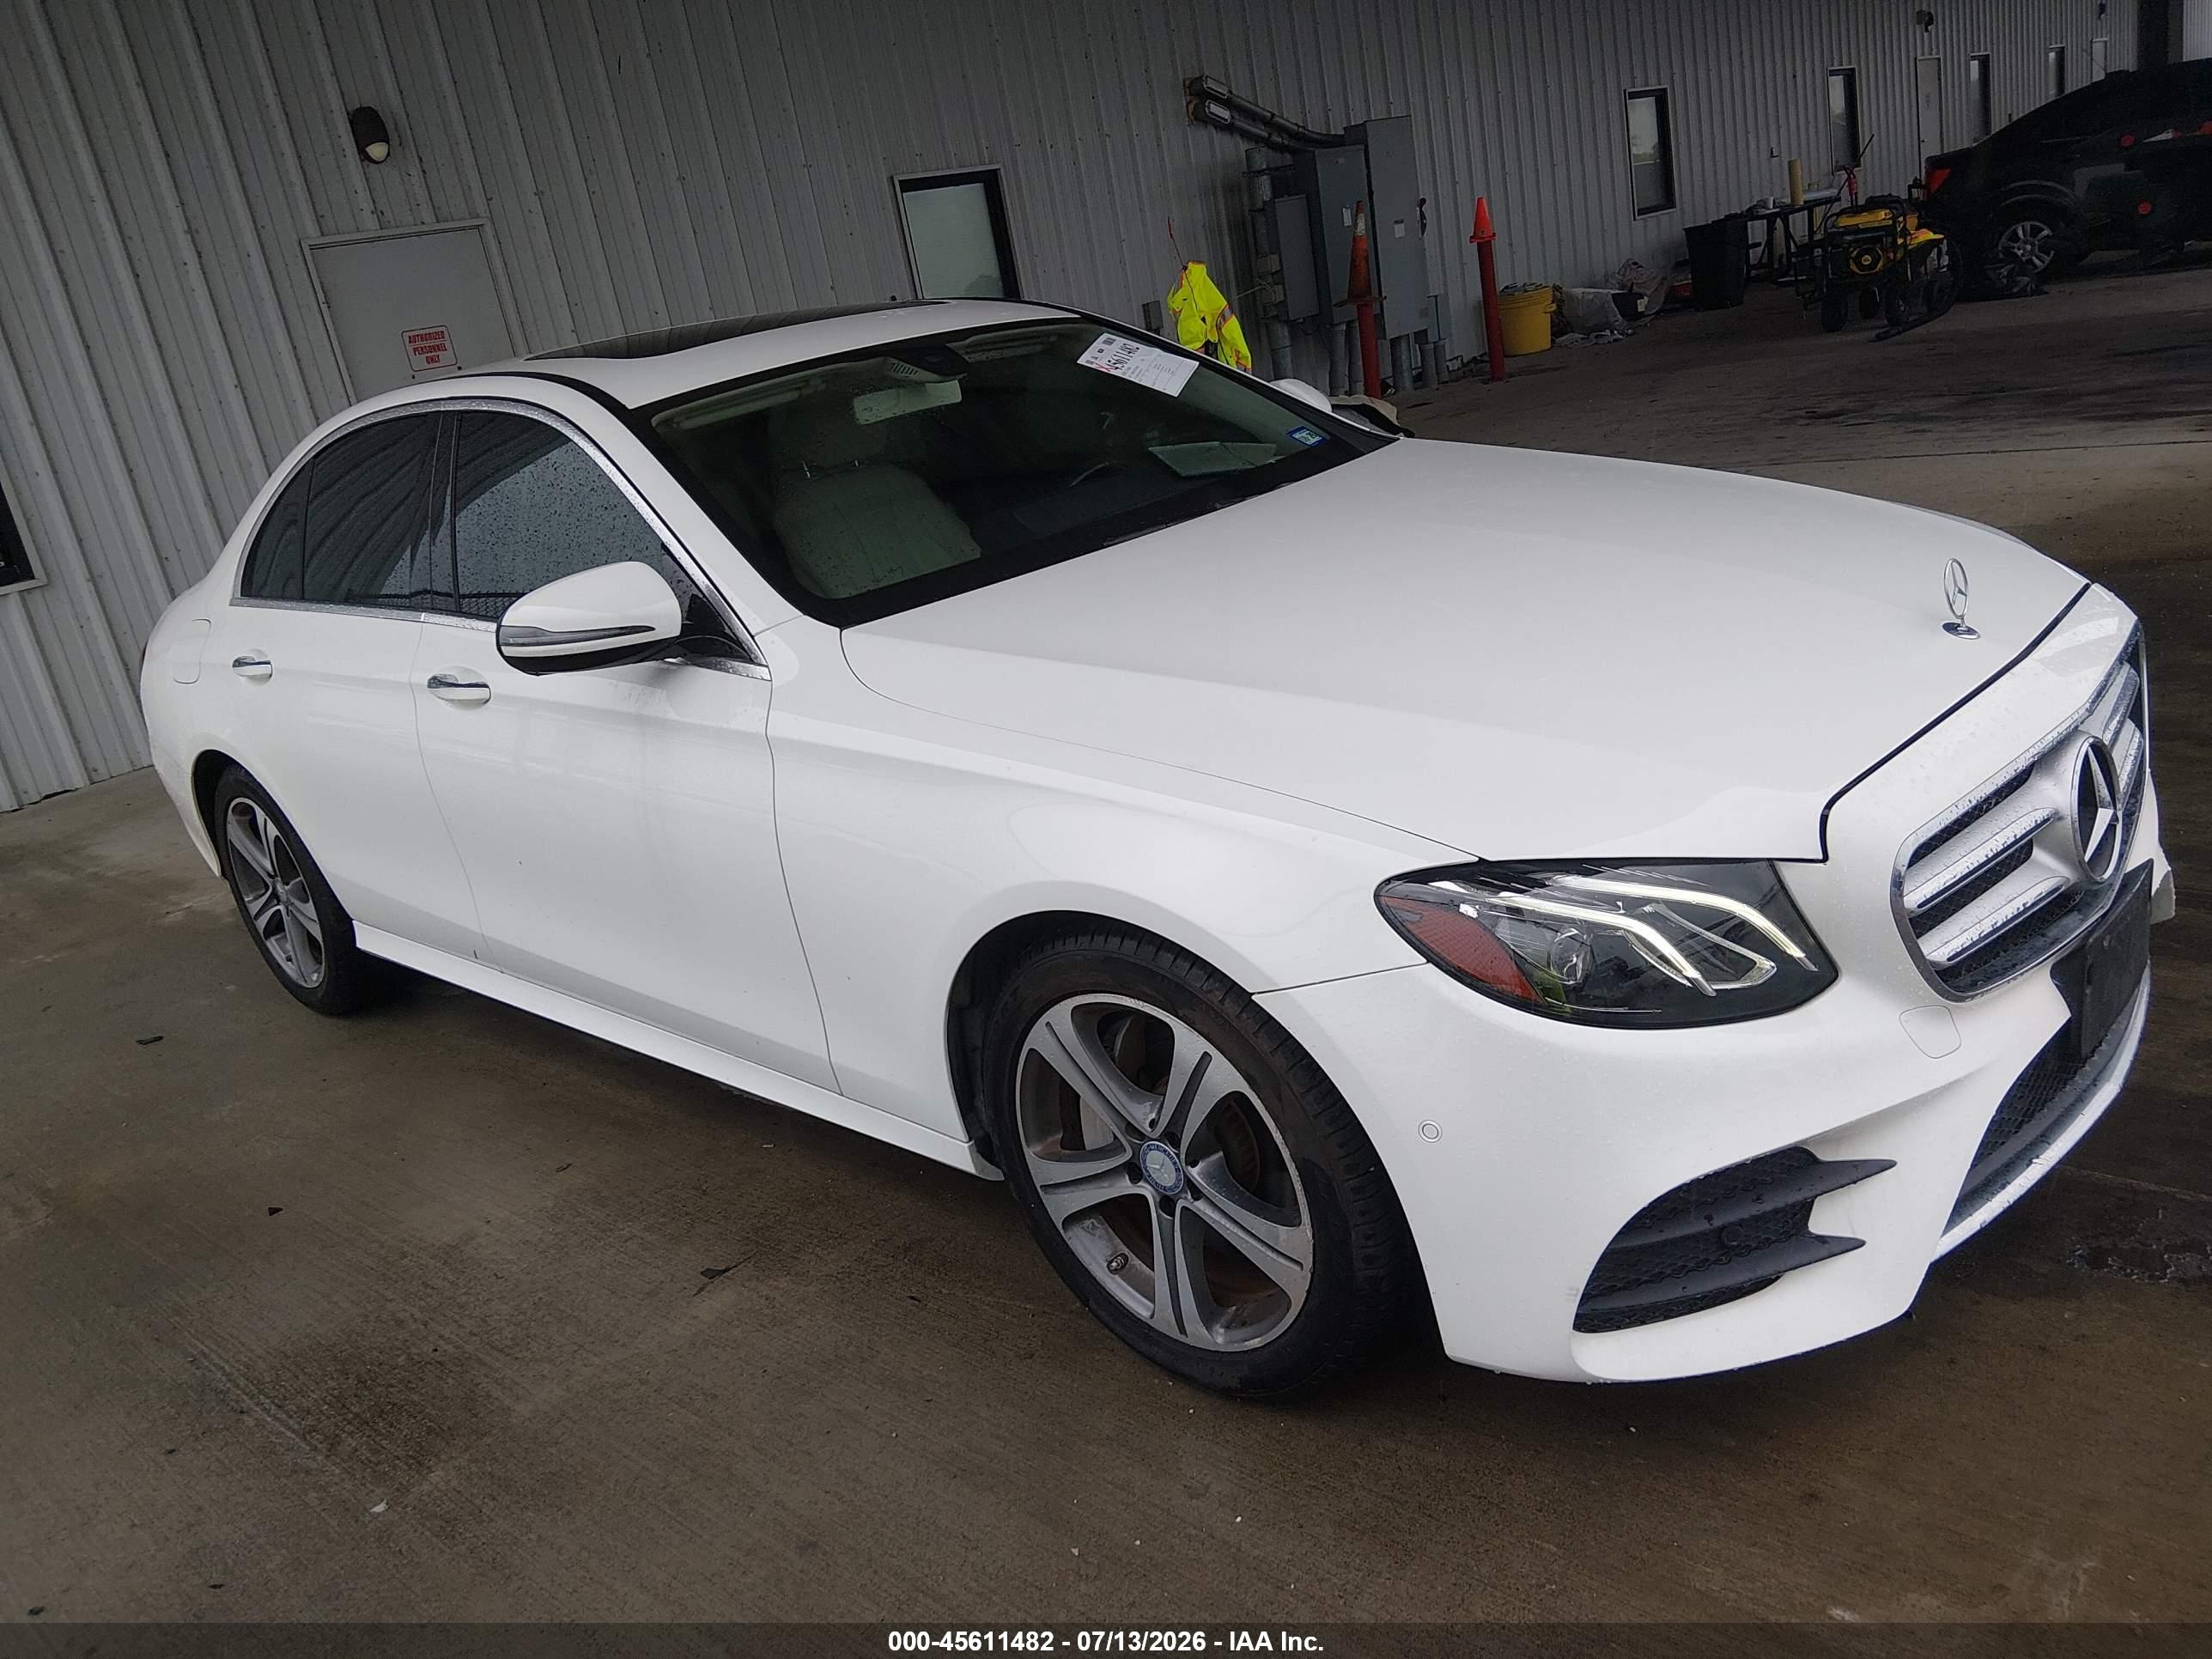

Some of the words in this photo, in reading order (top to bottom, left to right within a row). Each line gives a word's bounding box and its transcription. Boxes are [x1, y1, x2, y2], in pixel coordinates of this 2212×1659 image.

[408, 331, 446, 343] AUTHORIZED
[412, 343, 447, 356] PERSONNEL
[425, 355, 441, 365] ONLY
